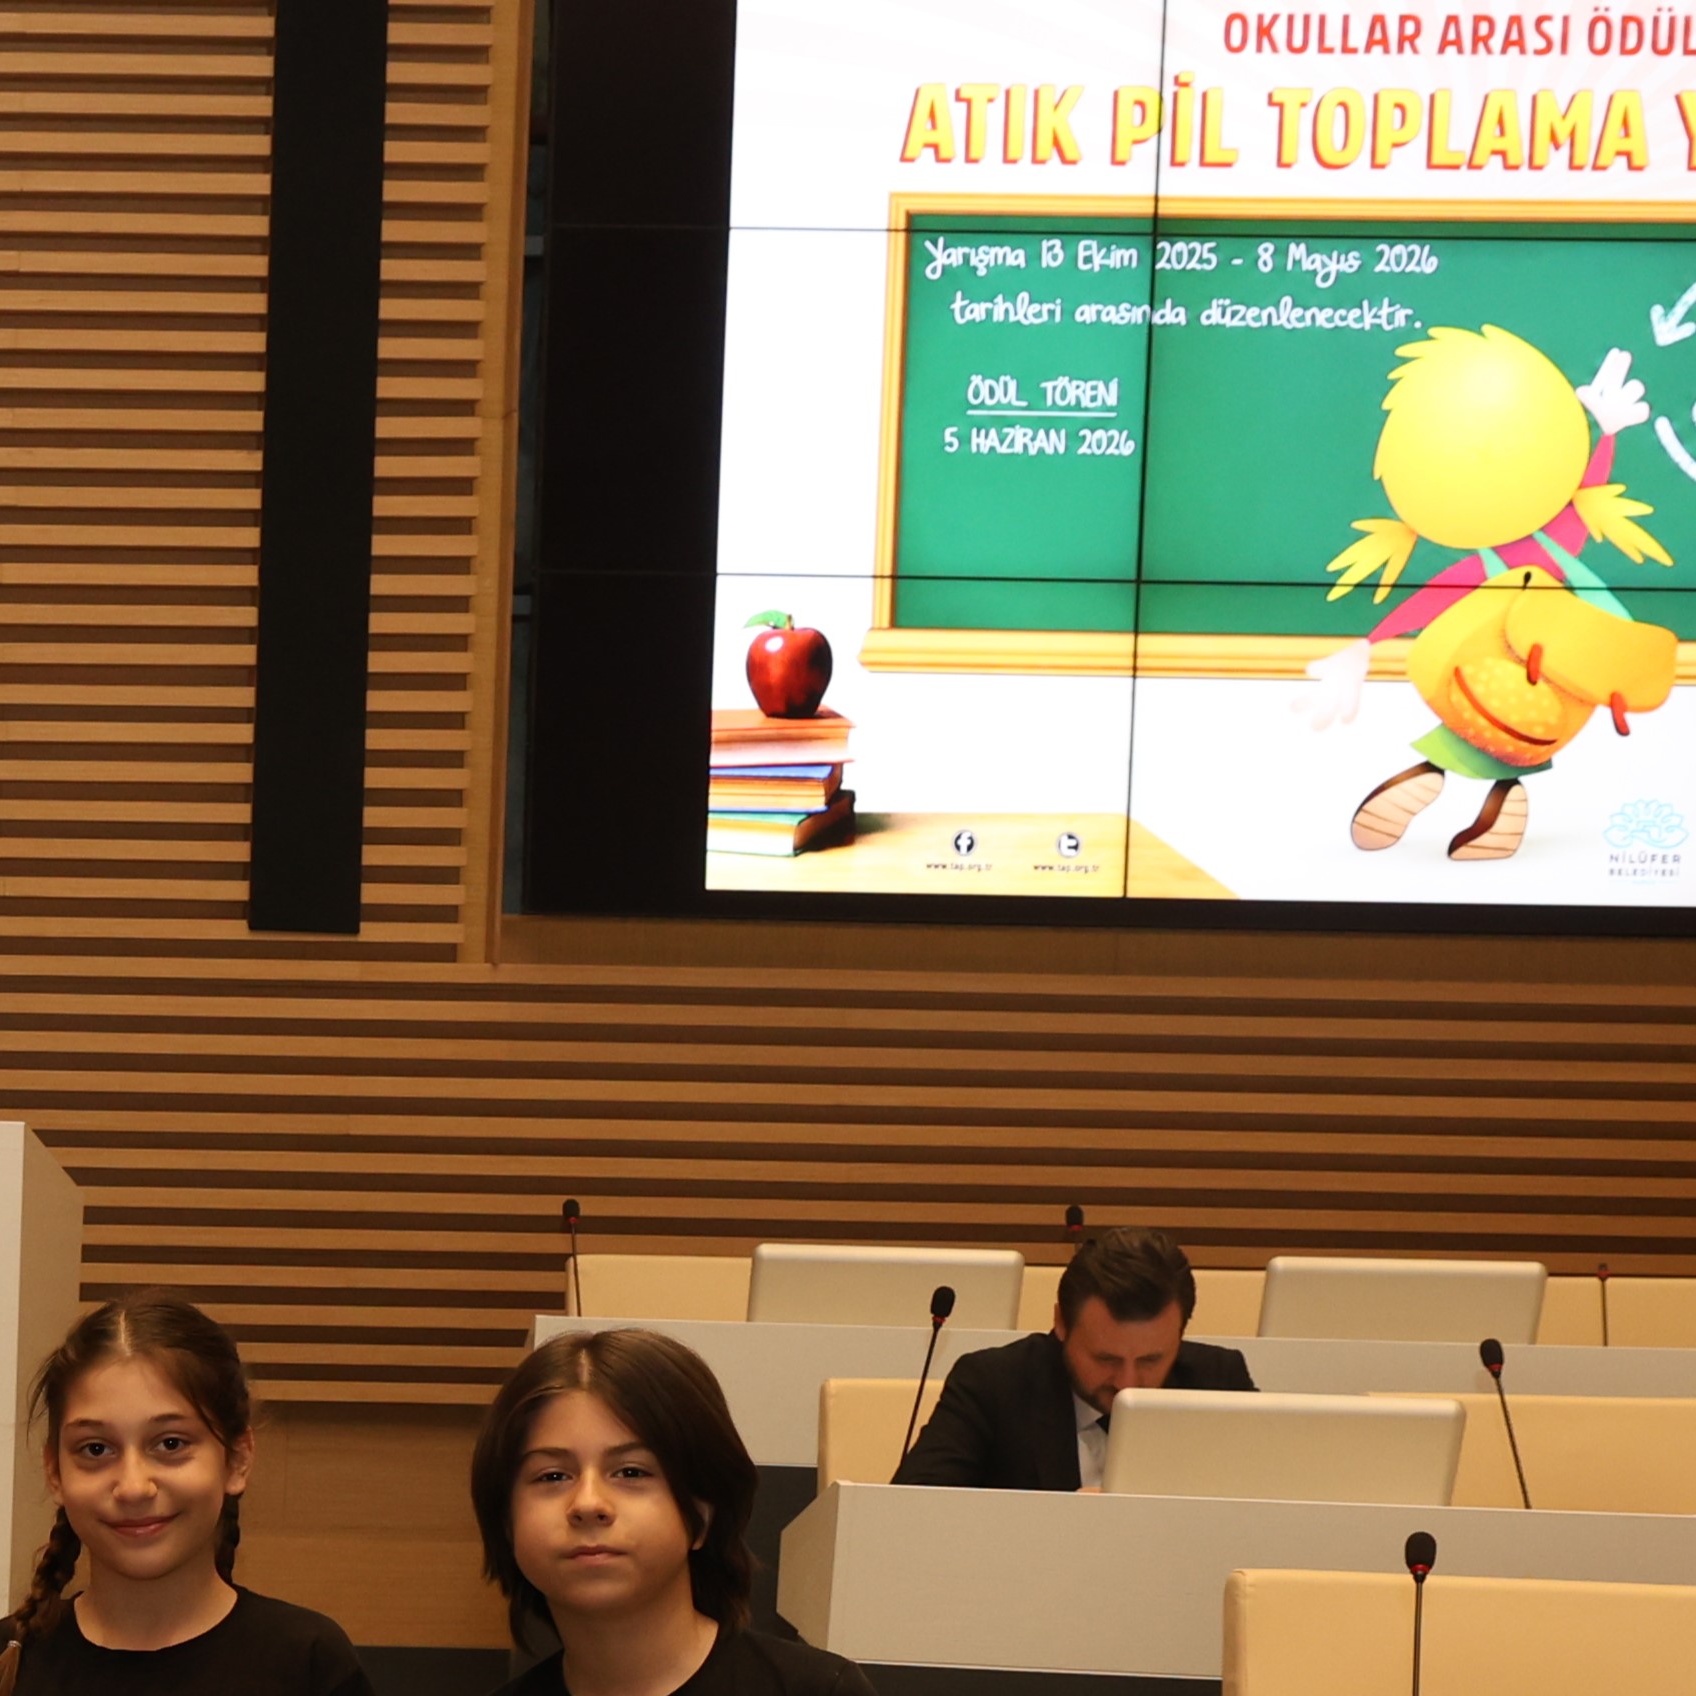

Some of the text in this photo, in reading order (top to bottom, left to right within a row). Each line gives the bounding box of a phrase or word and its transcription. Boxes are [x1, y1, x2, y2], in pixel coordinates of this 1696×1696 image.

[1223, 12, 1422, 55] OKULLAR
[1437, 13, 1570, 56] ARASI
[900, 82, 1084, 165] ATIK
[1110, 71, 1239, 167] PİL
[1268, 87, 1650, 171] TOPLAMA
[924, 237, 1025, 280] Yarışma
[1041, 239, 1064, 269] 13
[1078, 241, 1138, 270] Ekim
[1155, 241, 1218, 271] 2025
[1257, 242, 1273, 273] 8
[1286, 243, 1361, 288] Mayıs
[1375, 243, 1439, 274] 2026
[950, 291, 1422, 331] tarihleri arasında düzenlenecektir.
[967, 374, 1118, 408] ÖDÜL TÖRENİ
[943, 424, 1136, 456] 5 HAZİRAN 2026
